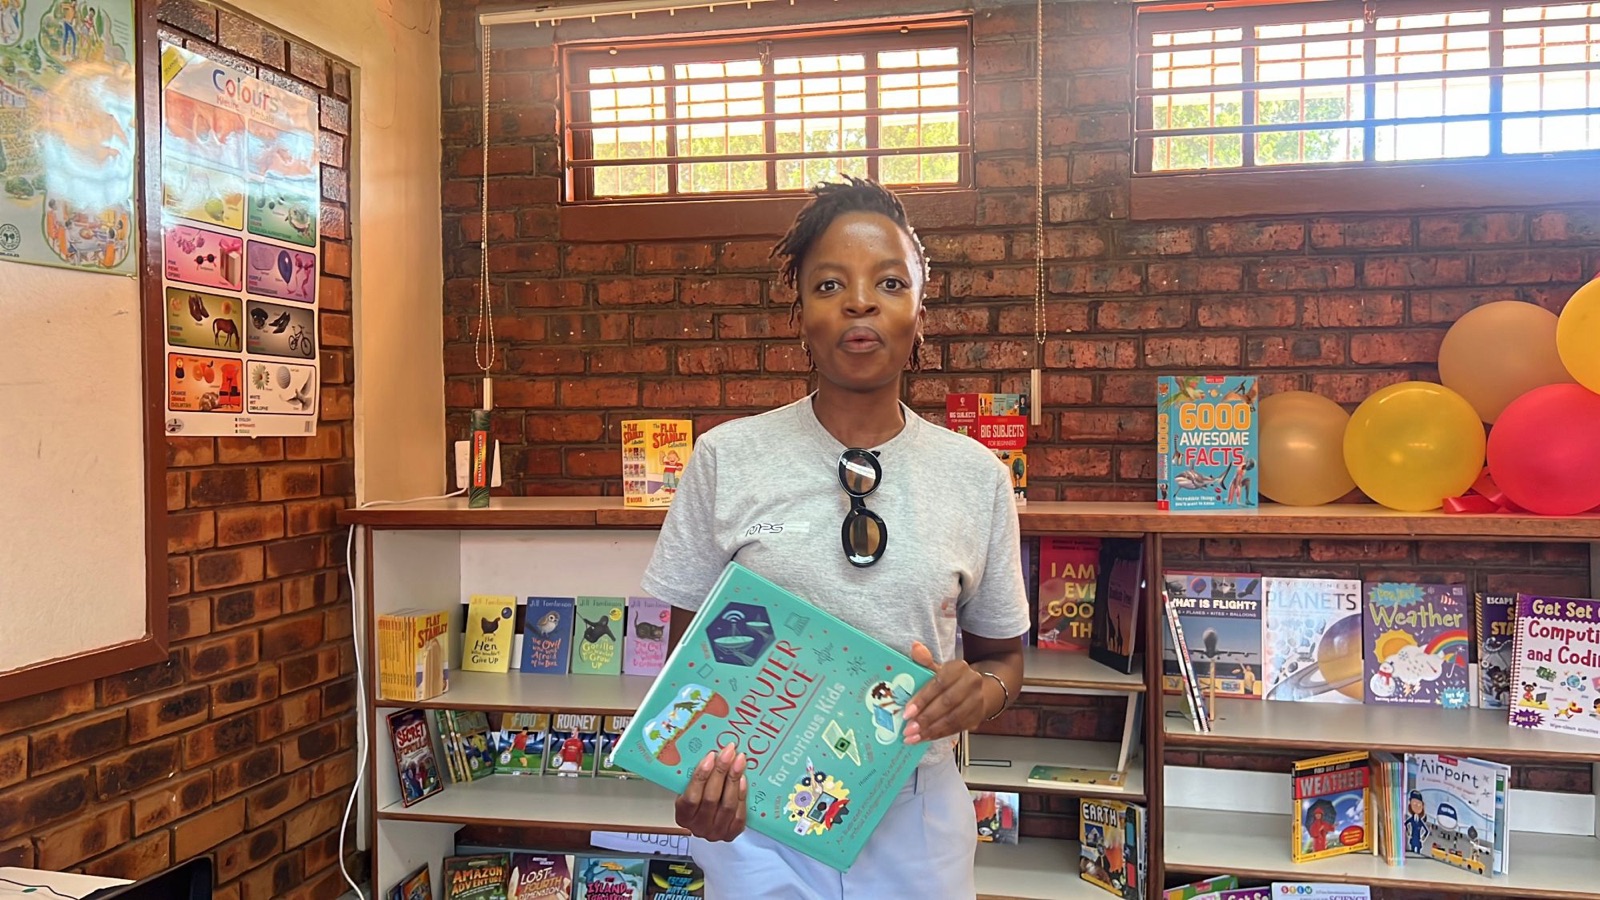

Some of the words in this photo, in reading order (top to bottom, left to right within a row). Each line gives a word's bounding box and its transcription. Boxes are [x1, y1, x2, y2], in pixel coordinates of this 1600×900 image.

[213, 69, 278, 112] Colours
[1180, 403, 1251, 430] 6000
[661, 423, 677, 432] FLAT
[980, 425, 991, 438] BIG
[993, 425, 1024, 438] SUBJECTS
[652, 433, 687, 449] STANLEY
[1180, 432, 1249, 446] AWESOME
[1185, 447, 1244, 466] FACTS
[1051, 562, 1056, 578] I
[1062, 563, 1095, 579] AM
[543, 600, 571, 608] Tomlinson
[1200, 600, 1210, 609] IS
[1213, 600, 1257, 610] FLIGHT?
[1266, 591, 1357, 610] PLANETS
[1532, 599, 1561, 616] Get
[1566, 602, 1593, 619] Set
[426, 614, 440, 628] FLAT
[1369, 602, 1463, 628] Weather
[418, 623, 447, 648] STANLEY
[474, 640, 497, 651] Hen
[583, 642, 614, 651] Gorilla
[472, 655, 487, 664] Give
[1527, 649, 1552, 662] and
[557, 714, 596, 730] ROONEY
[1516, 715, 1528, 723] Ages
[396, 721, 424, 747] SECRET
[768, 764, 790, 788] for
[782, 714, 826, 766] Curious
[815, 682, 846, 715] Kids
[1300, 769, 1364, 797] WEATHER
[1420, 759, 1479, 789] Airport
[1082, 802, 1118, 827] EARTH
[453, 866, 503, 884] AMAZON
[520, 867, 553, 885] LOST
[524, 875, 563, 893] FOURTH
[451, 877, 503, 896] ADVENTURE
[588, 880, 627, 893] ISLAND
